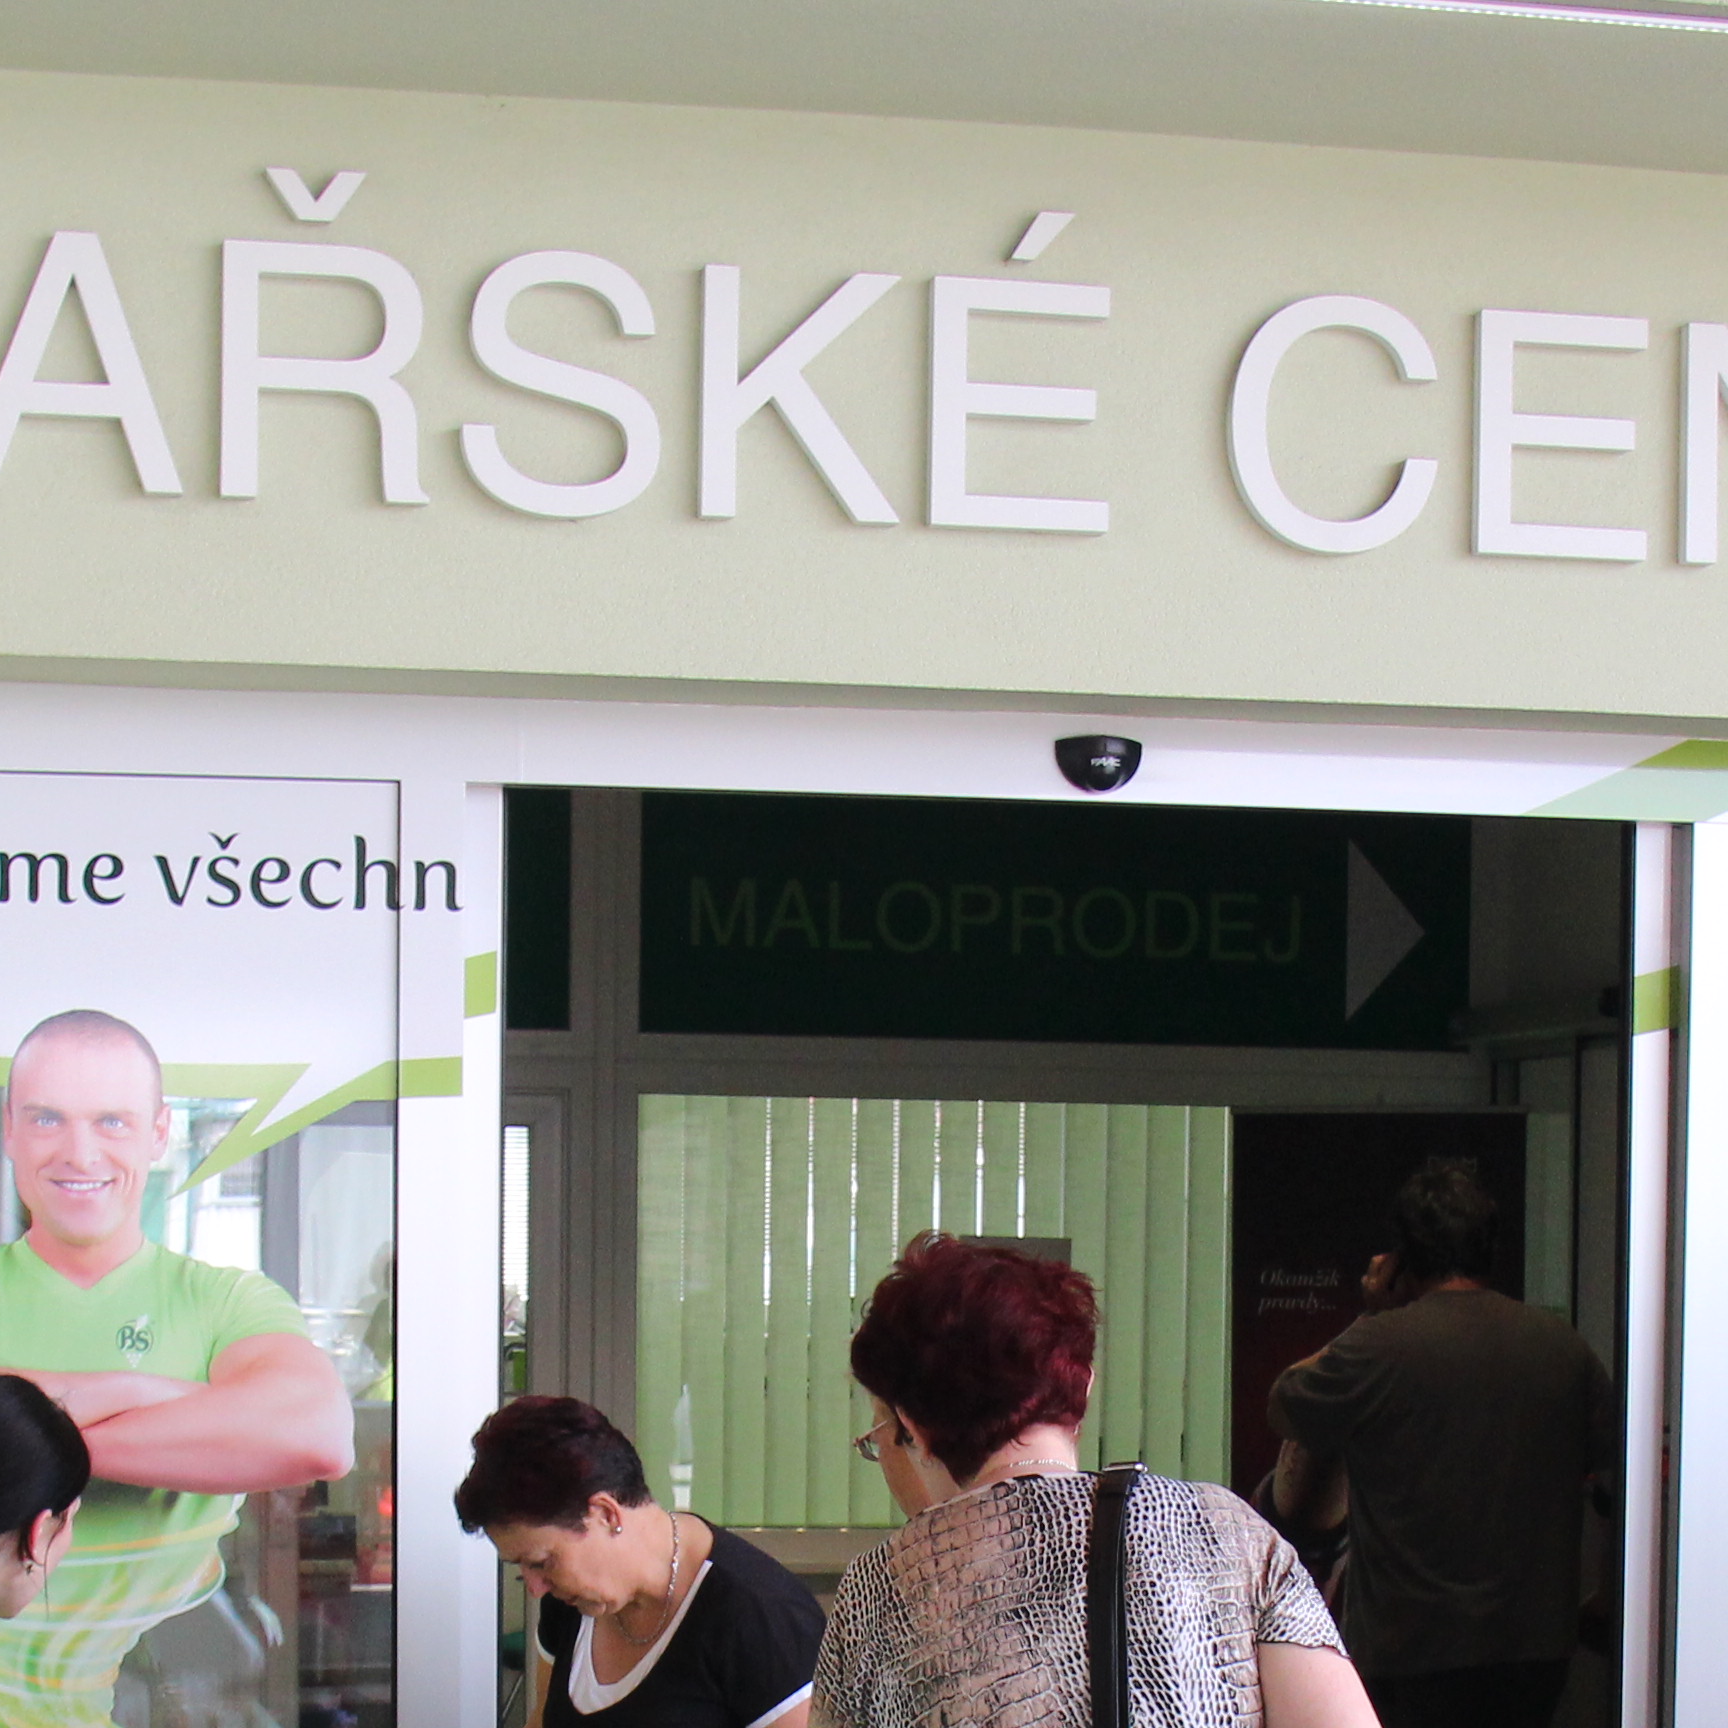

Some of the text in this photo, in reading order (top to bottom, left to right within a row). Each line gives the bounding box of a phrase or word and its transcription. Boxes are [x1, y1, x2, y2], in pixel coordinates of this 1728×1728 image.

[154, 832, 464, 912] všechn
[689, 874, 1305, 964] MALOPRODEJ
[117, 1326, 149, 1352] BS
